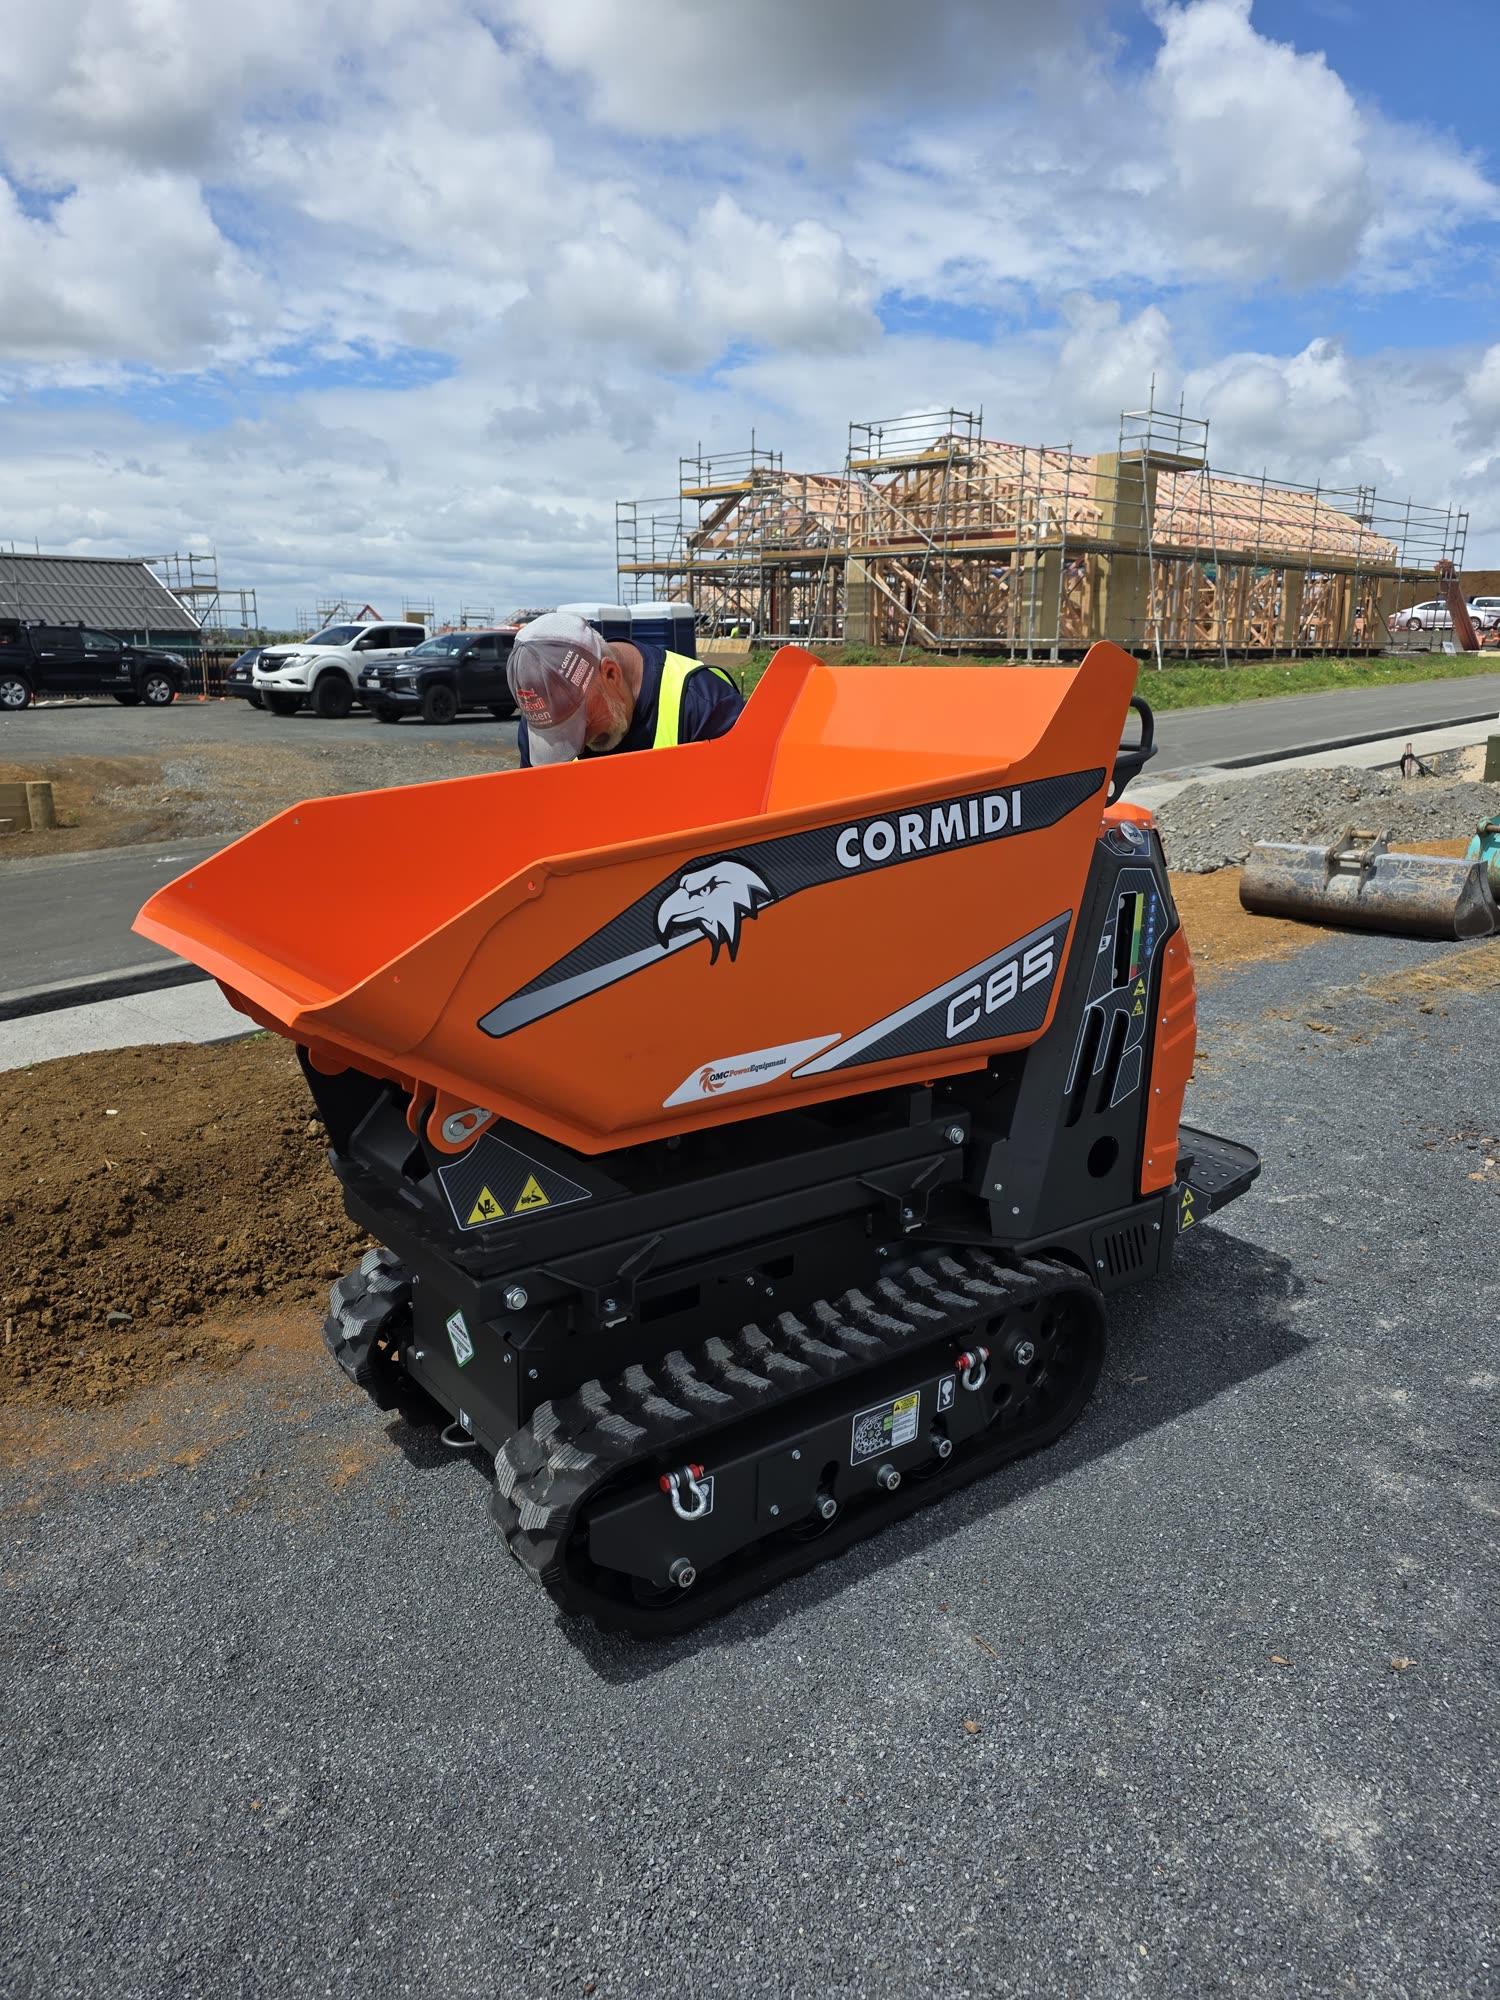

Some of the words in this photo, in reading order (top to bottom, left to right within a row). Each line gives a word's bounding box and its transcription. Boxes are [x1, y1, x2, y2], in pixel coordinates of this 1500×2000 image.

[561, 649, 574, 669] CALTEX
[836, 790, 1022, 868] CORMIDI
[946, 935, 1054, 1039] C85
